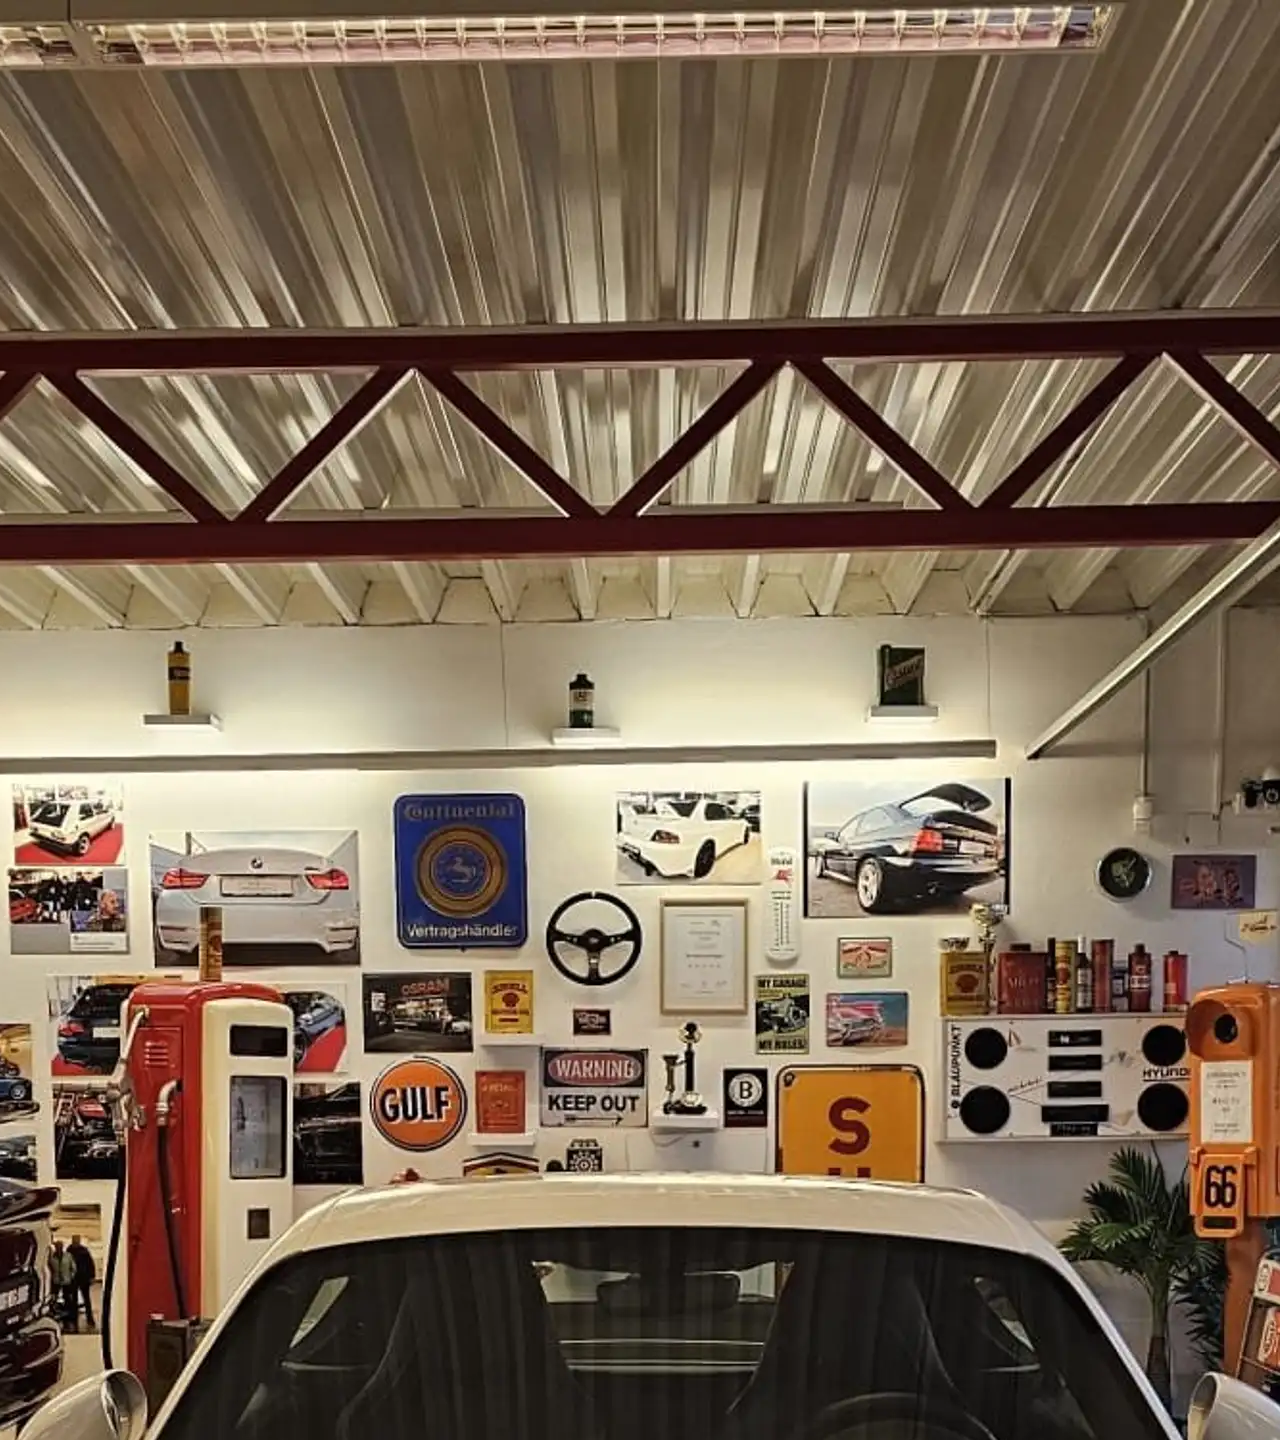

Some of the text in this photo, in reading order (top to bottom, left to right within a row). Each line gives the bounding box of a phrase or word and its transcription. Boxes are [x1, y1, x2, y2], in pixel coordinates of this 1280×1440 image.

[405, 803, 515, 821] Continental
[407, 923, 518, 939] Vertragshändler
[401, 978, 451, 997] OSRAM
[556, 1059, 634, 1078] WARNING
[739, 1081, 753, 1099] B
[379, 1086, 451, 1123] GULF
[548, 1095, 640, 1112] KEEP OUT
[1205, 1165, 1237, 1209] 66
